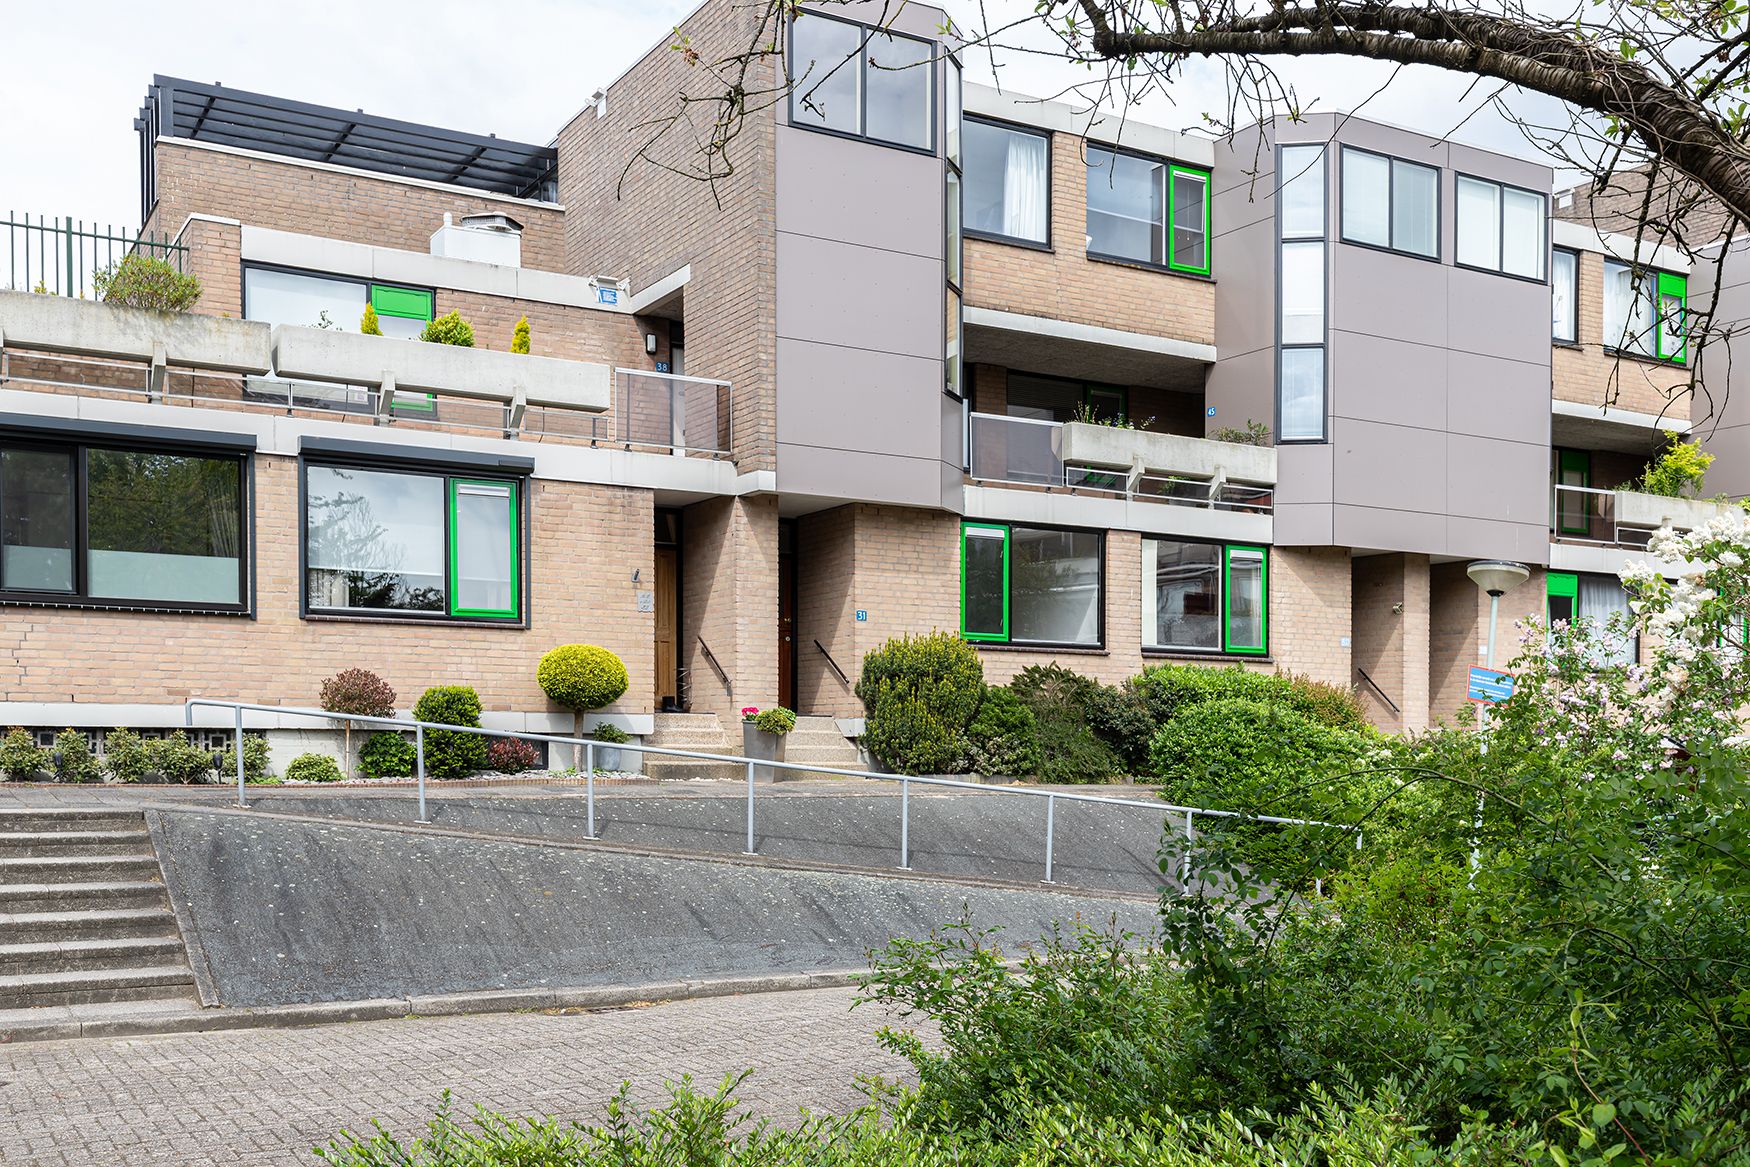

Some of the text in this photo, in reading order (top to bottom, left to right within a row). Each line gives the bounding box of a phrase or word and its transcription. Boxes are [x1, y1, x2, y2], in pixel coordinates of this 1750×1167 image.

[657, 362, 668, 372] 38
[1208, 407, 1215, 416] 45
[857, 611, 866, 620] 31
